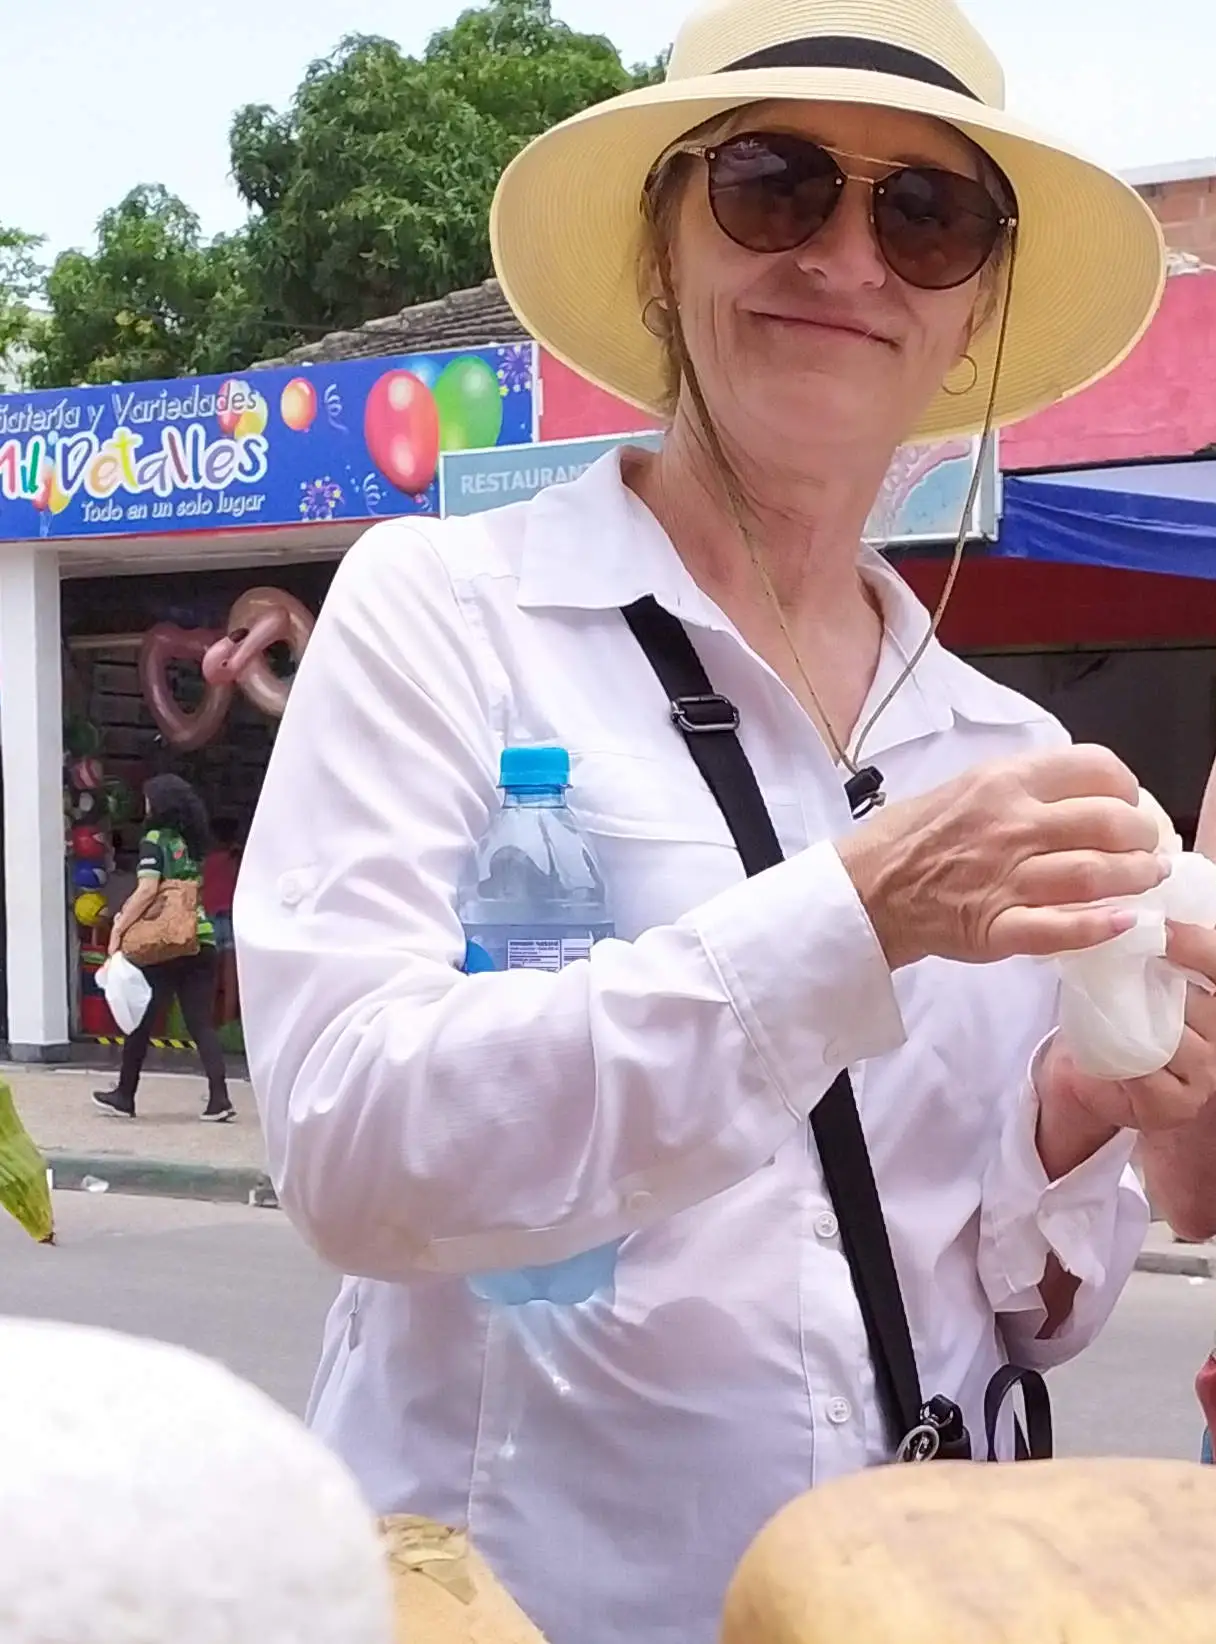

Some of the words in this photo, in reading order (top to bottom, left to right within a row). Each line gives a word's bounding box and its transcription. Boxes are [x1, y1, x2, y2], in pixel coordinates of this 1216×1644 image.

[87, 403, 104, 434] y
[112, 384, 257, 425] Variedades
[58, 425, 267, 497] Detalles
[460, 463, 593, 495] RESTAURAN
[81, 499, 123, 522] Todo
[126, 501, 148, 520] en
[152, 501, 173, 518] un
[176, 492, 213, 516] solo
[216, 491, 266, 517] lugar
